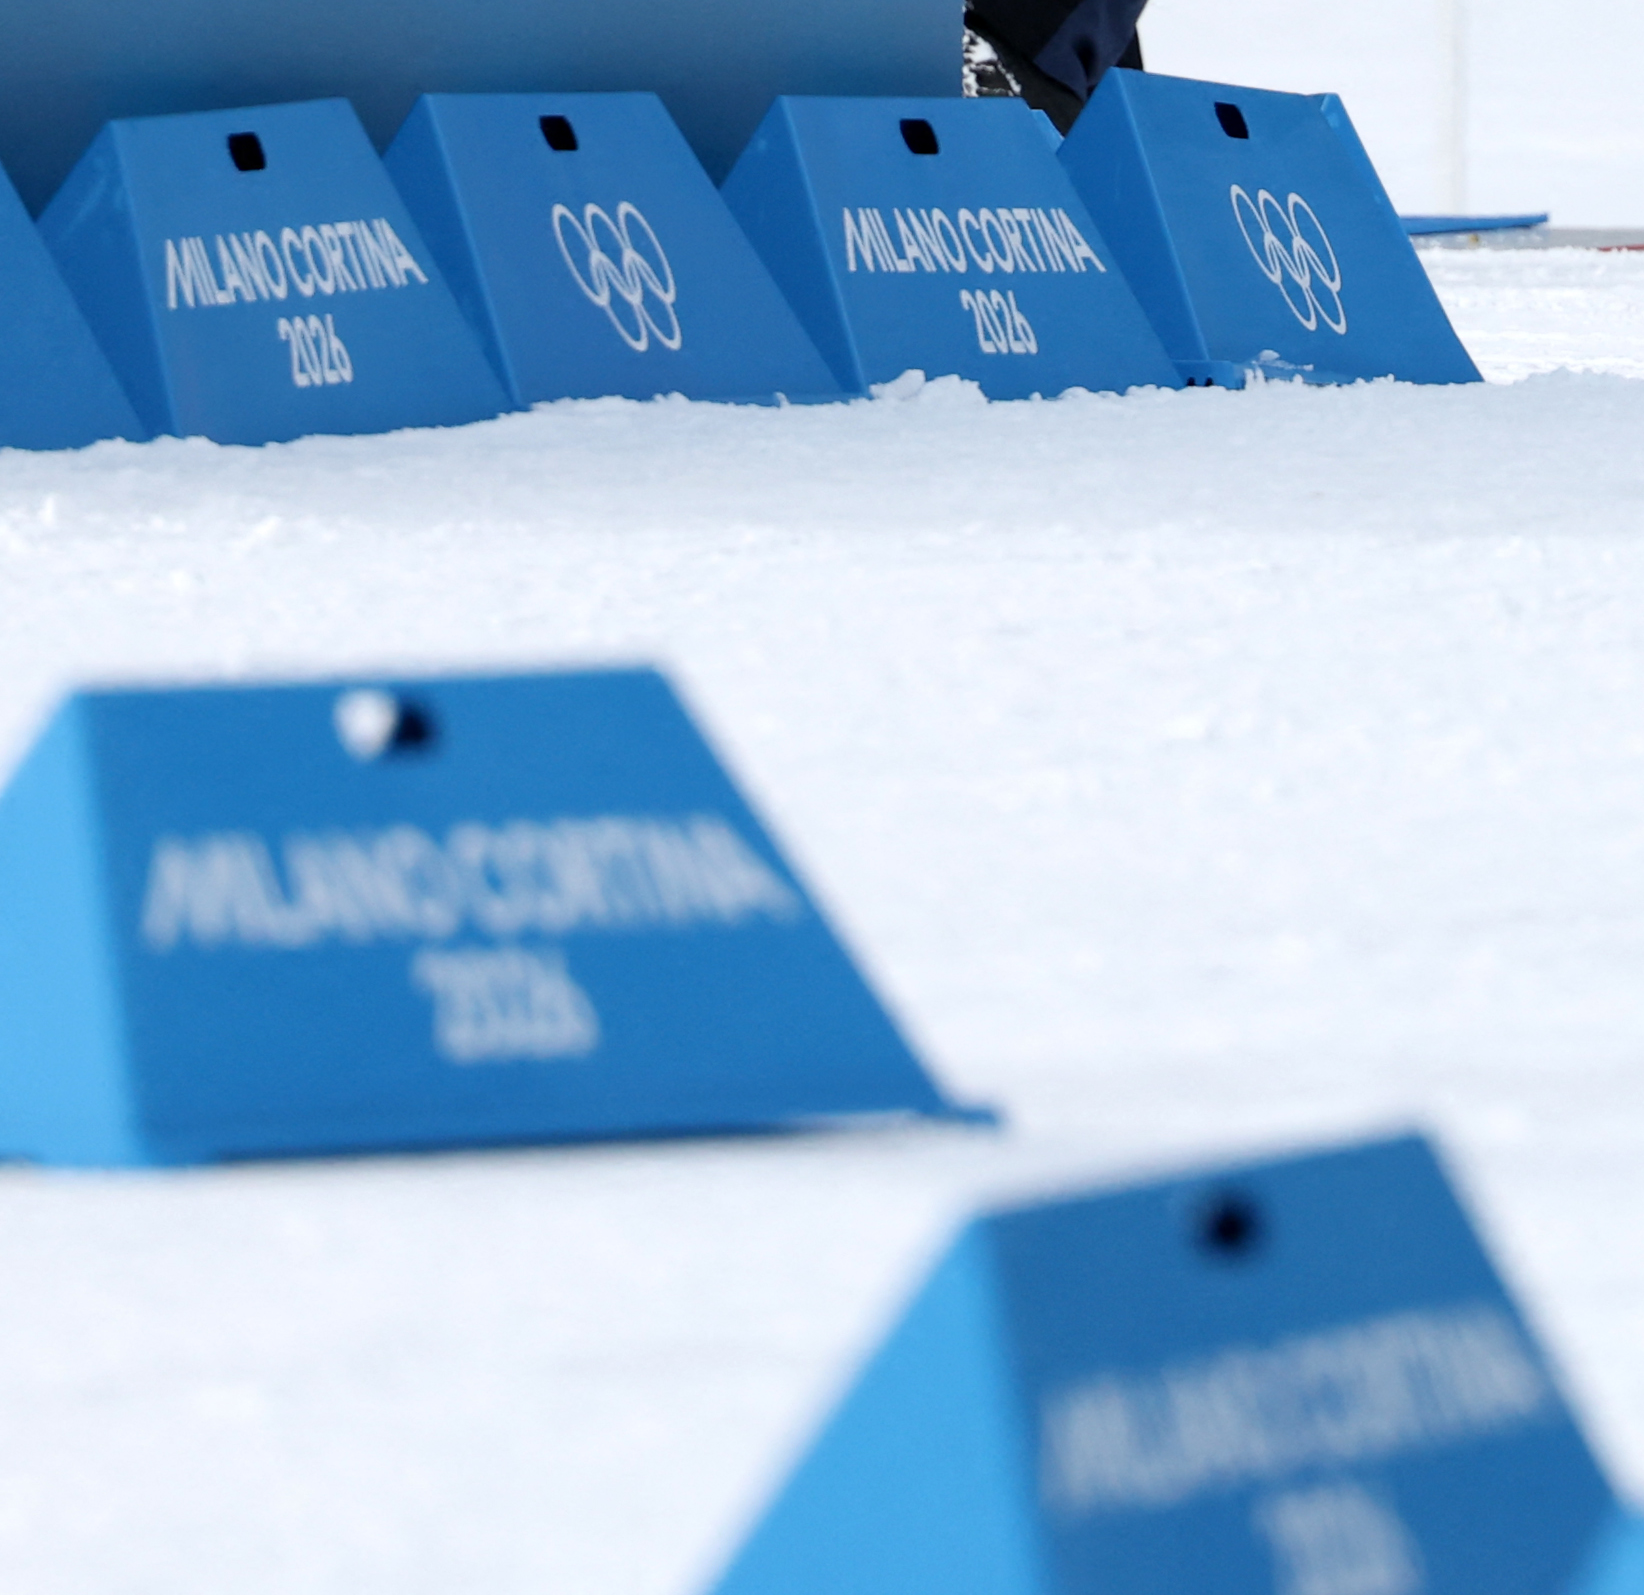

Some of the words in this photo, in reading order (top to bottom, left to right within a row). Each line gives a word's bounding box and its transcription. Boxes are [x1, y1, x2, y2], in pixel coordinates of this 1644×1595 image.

[165, 229, 288, 310] MILANO
[280, 217, 429, 299] CORTINA
[842, 206, 968, 273] MILANO
[957, 207, 1106, 273] CORTINA
[278, 314, 354, 387] 2026
[959, 289, 1038, 355] 2026
